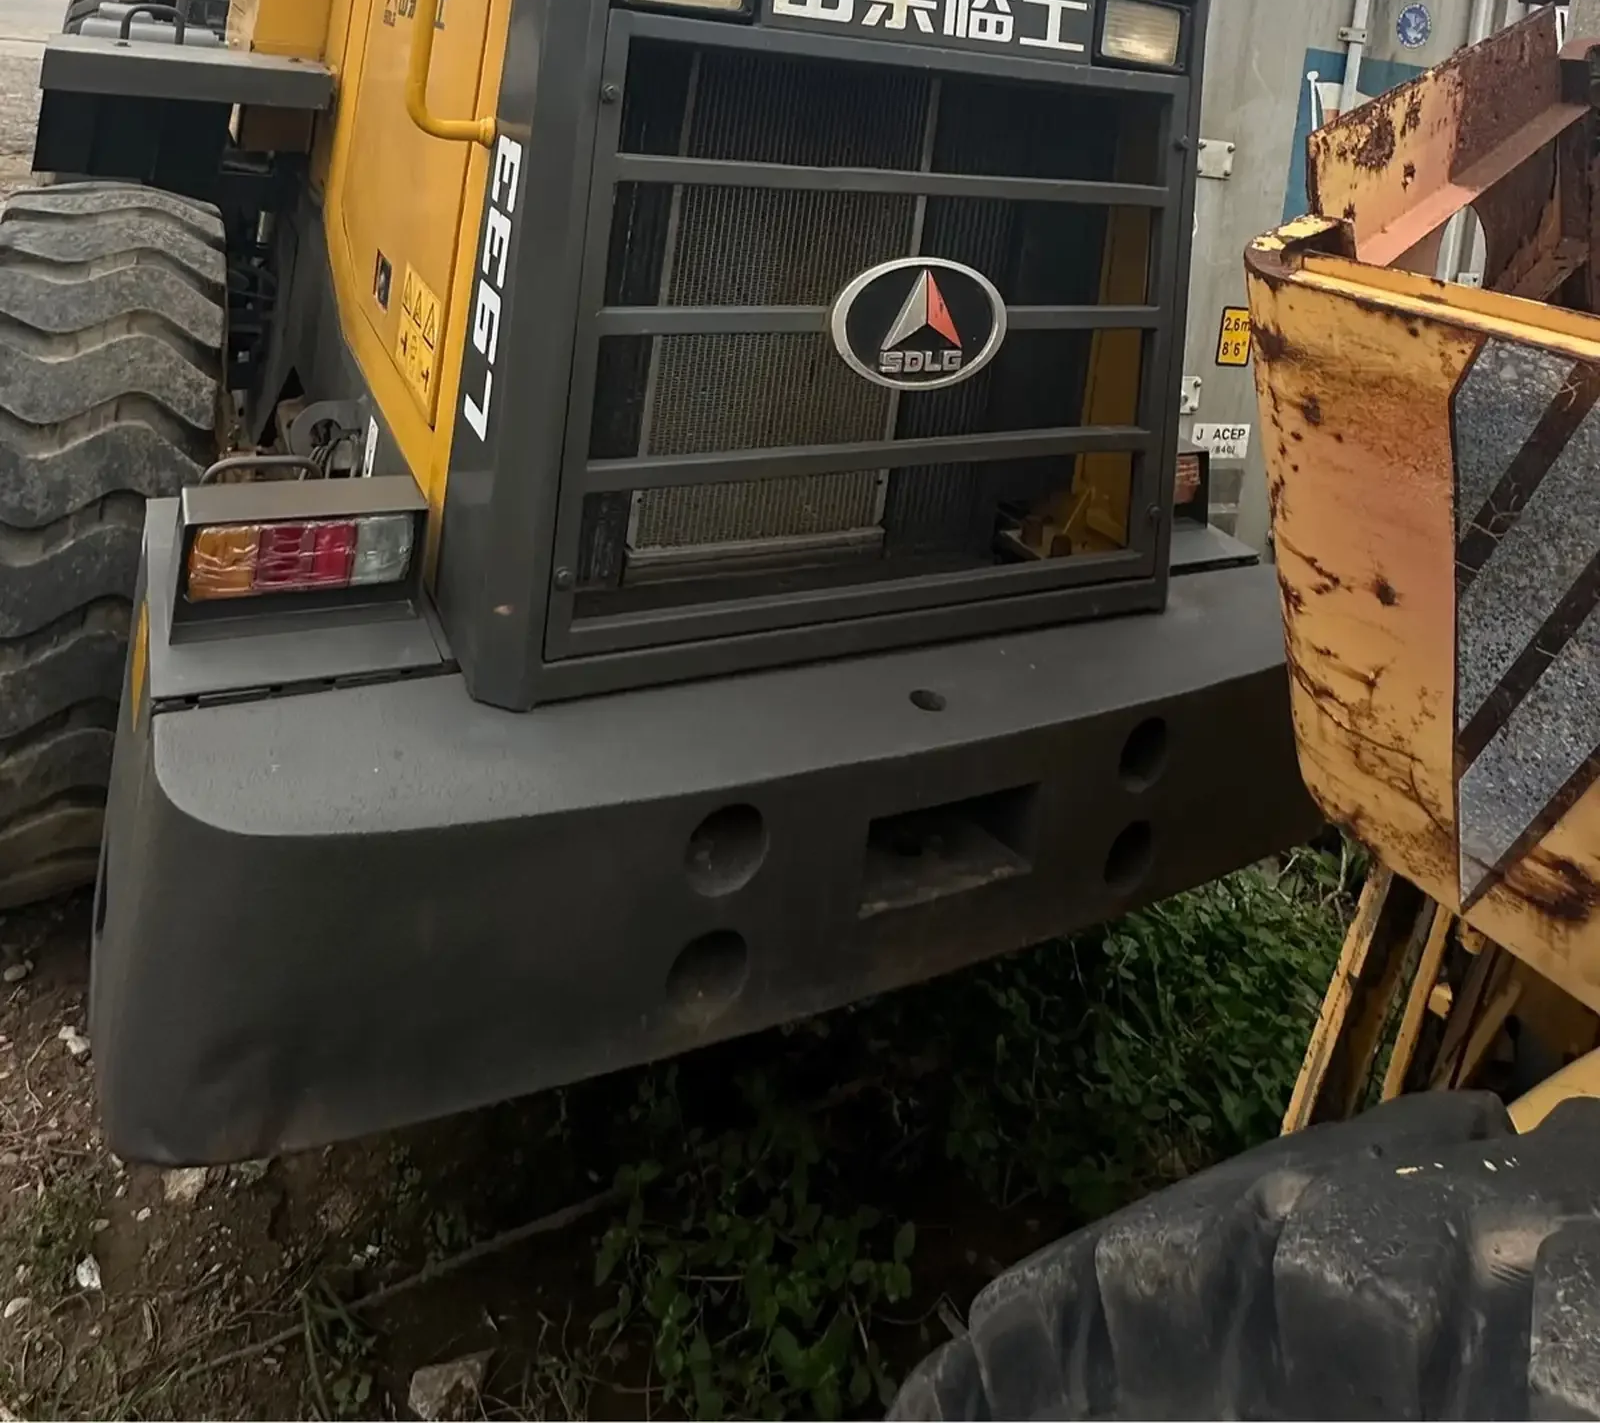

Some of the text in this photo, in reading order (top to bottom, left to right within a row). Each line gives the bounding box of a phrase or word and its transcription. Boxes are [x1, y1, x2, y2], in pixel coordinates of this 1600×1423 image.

[463, 134, 523, 442] L933
[880, 350, 962, 374] SDLG
[1212, 427, 1246, 441] ACEP
